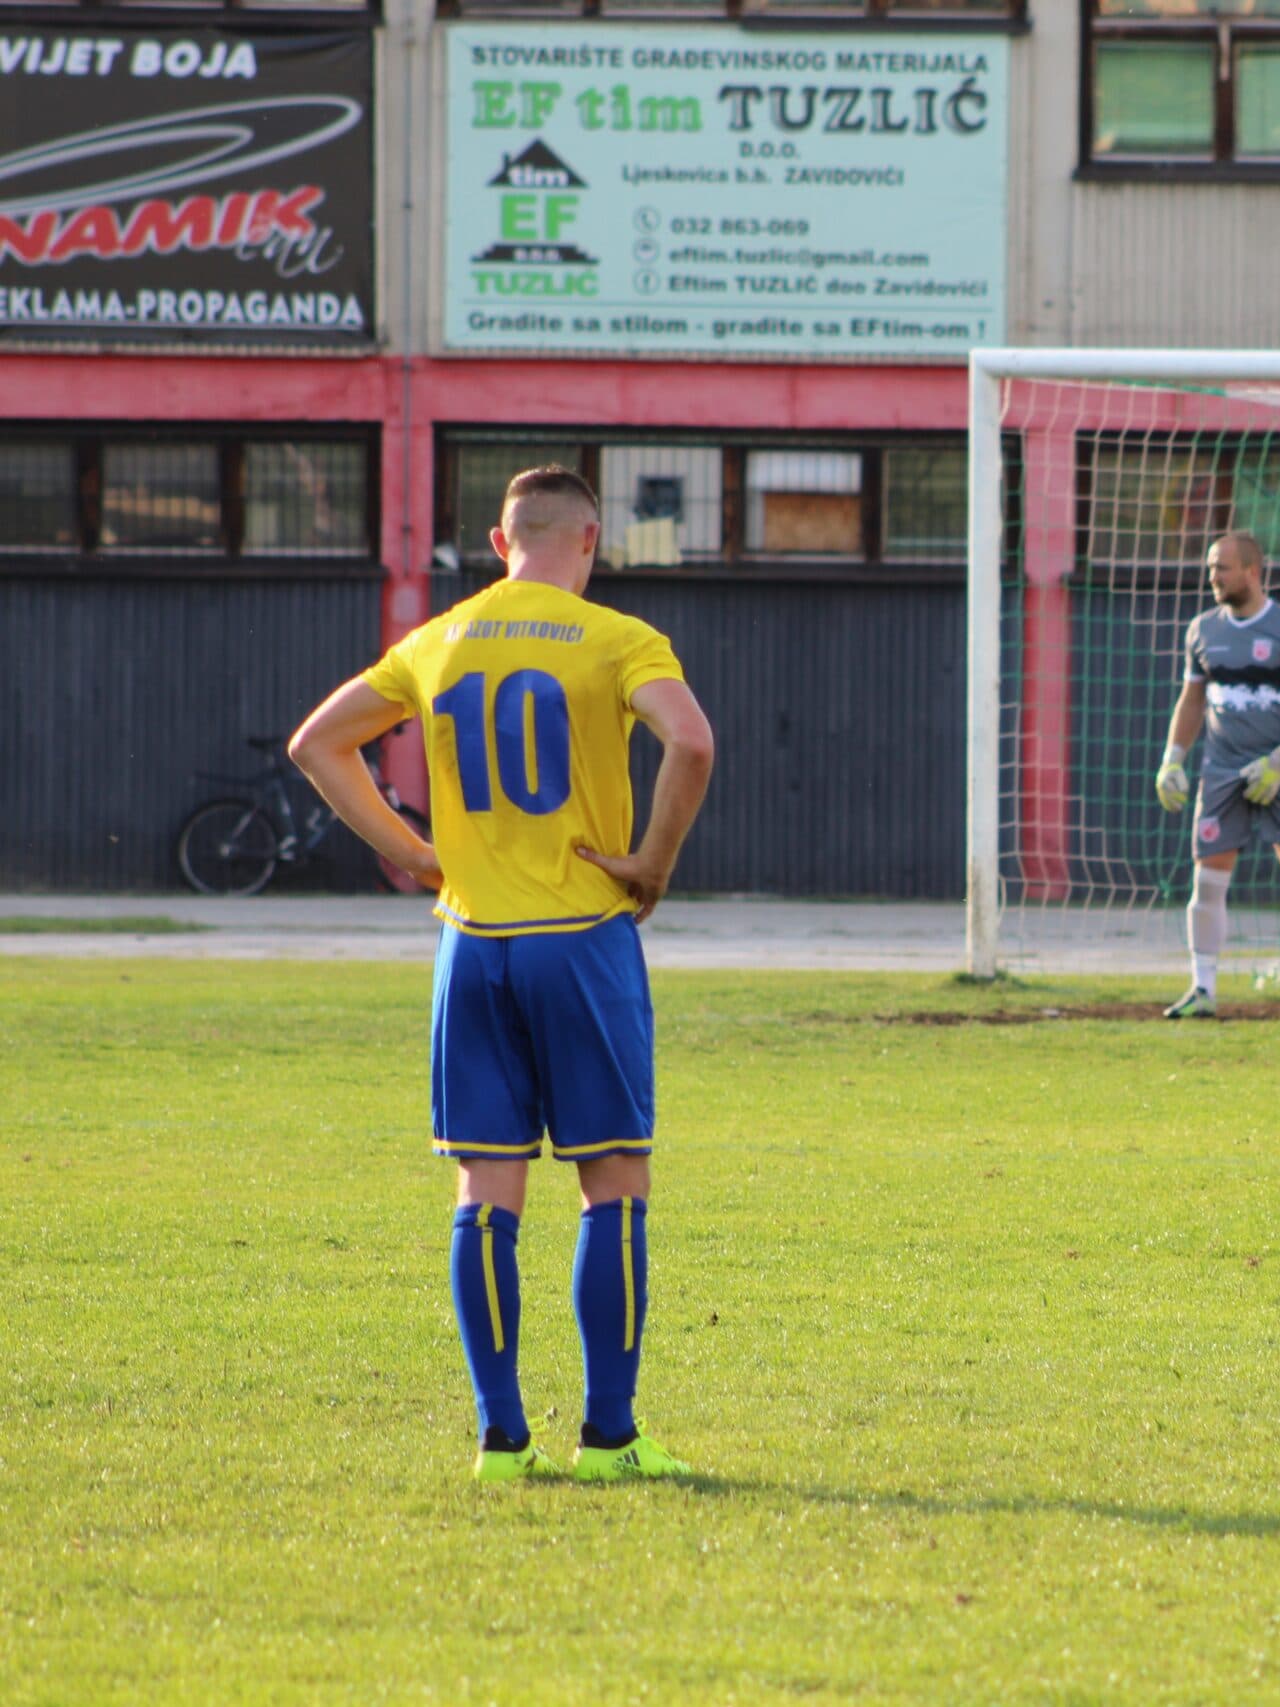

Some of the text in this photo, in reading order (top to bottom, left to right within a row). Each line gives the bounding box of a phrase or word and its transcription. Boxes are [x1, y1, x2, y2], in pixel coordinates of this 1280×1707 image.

[130, 40, 257, 78] BOJA
[471, 43, 623, 68] STOVARIŠTE
[836, 52, 988, 73] MATERIJALA
[471, 76, 988, 134] EF tim TUZLIĆ
[502, 194, 578, 240] EF
[671, 217, 711, 234] 032
[669, 274, 727, 292] Eftim
[826, 278, 866, 294] doo
[468, 311, 562, 332] Gradite
[572, 316, 601, 333] sa
[610, 315, 688, 334] stilom
[713, 316, 803, 338] gradite
[813, 320, 841, 336] sa
[851, 317, 970, 339] EFtim-om
[432, 668, 571, 816] 10
